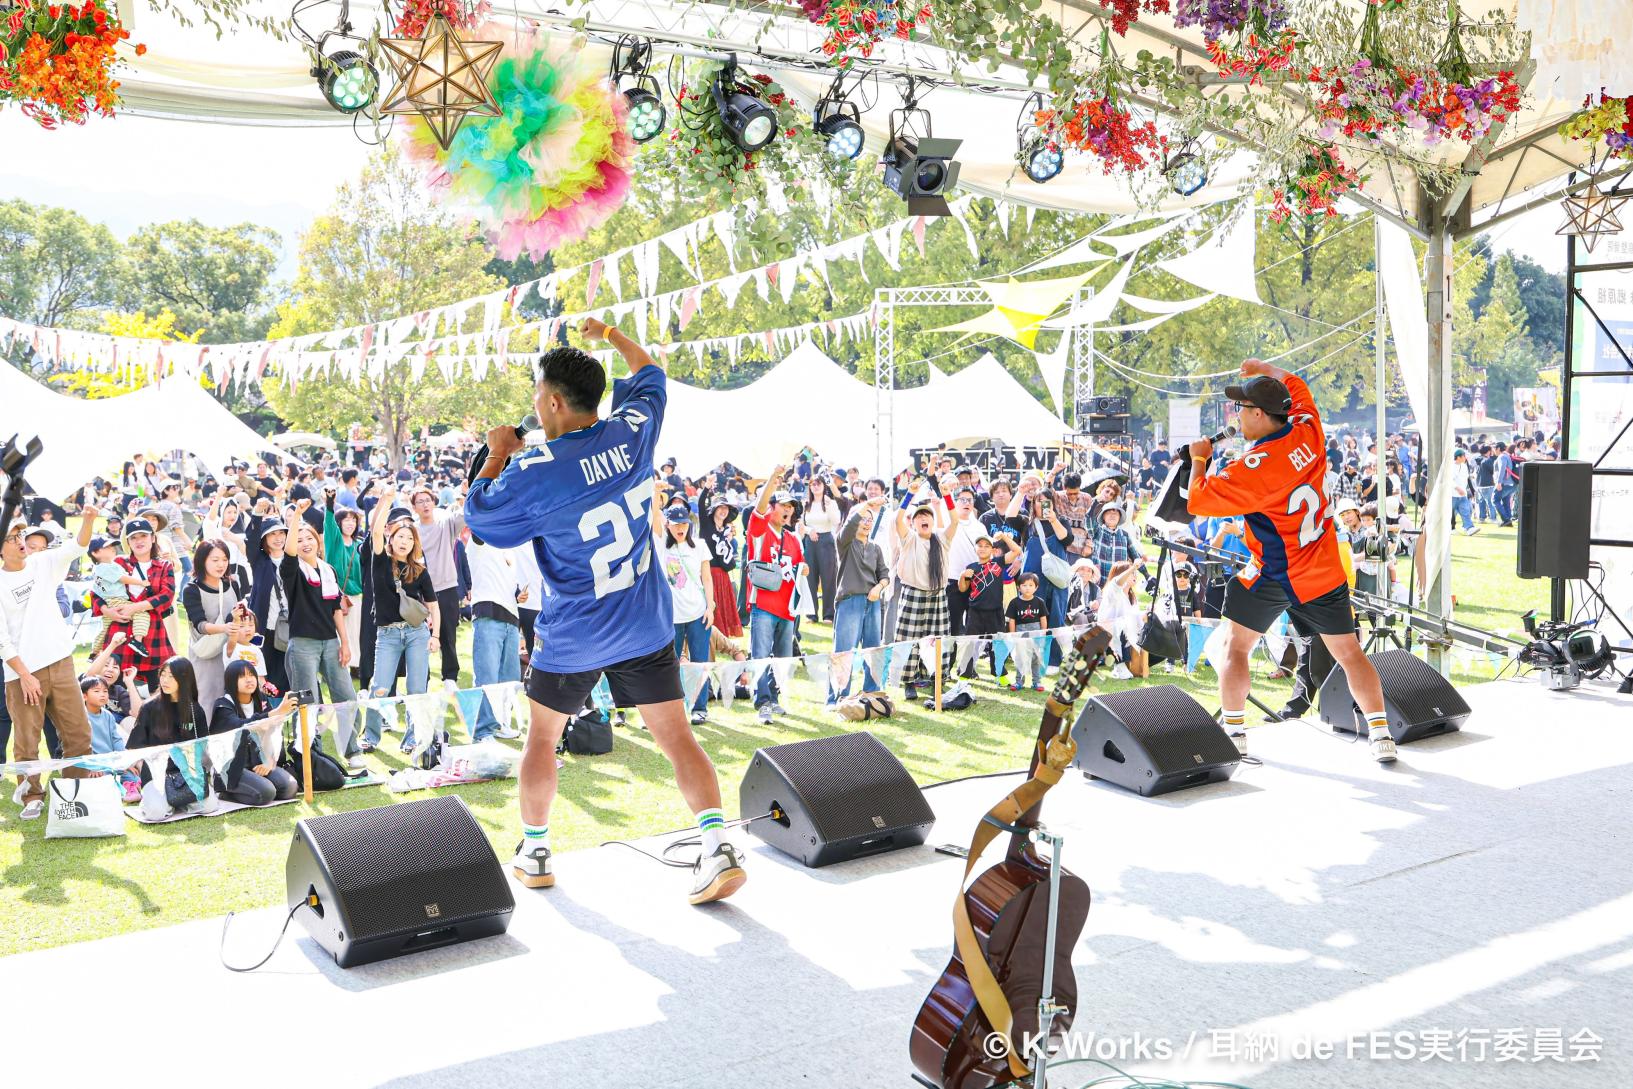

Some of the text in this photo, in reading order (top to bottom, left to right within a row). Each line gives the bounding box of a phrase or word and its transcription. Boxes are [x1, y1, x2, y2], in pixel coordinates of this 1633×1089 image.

[579, 443, 634, 486] DAYNE
[1287, 442, 1317, 472] BELL
[60, 801, 75, 809] THE
[58, 812, 76, 820] FACE
